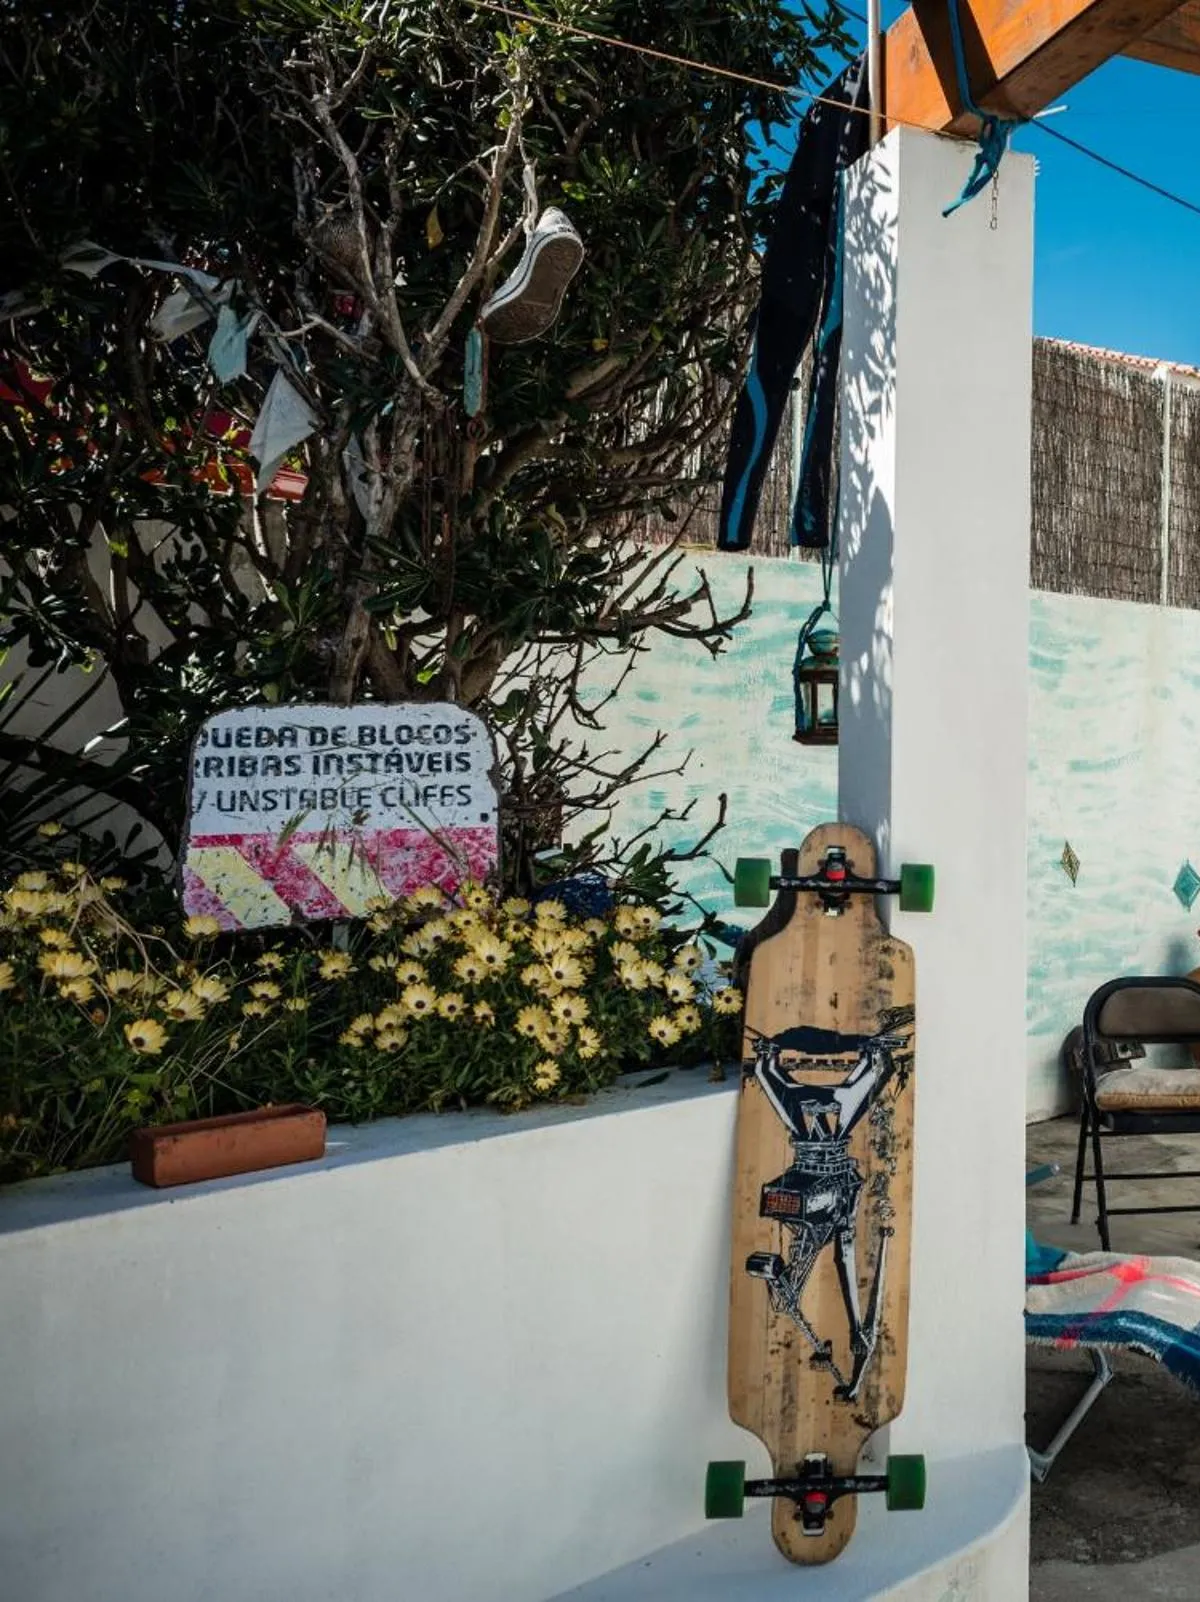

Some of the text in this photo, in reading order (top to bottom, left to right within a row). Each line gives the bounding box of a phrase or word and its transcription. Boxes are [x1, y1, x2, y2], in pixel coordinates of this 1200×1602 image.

[309, 725, 347, 746] DE
[358, 724, 472, 745] BLOCOS
[195, 747, 472, 778] RIBAS INSTÁVEIS
[217, 787, 372, 812] UNSTABLE
[379, 785, 472, 807] CLIFFS
